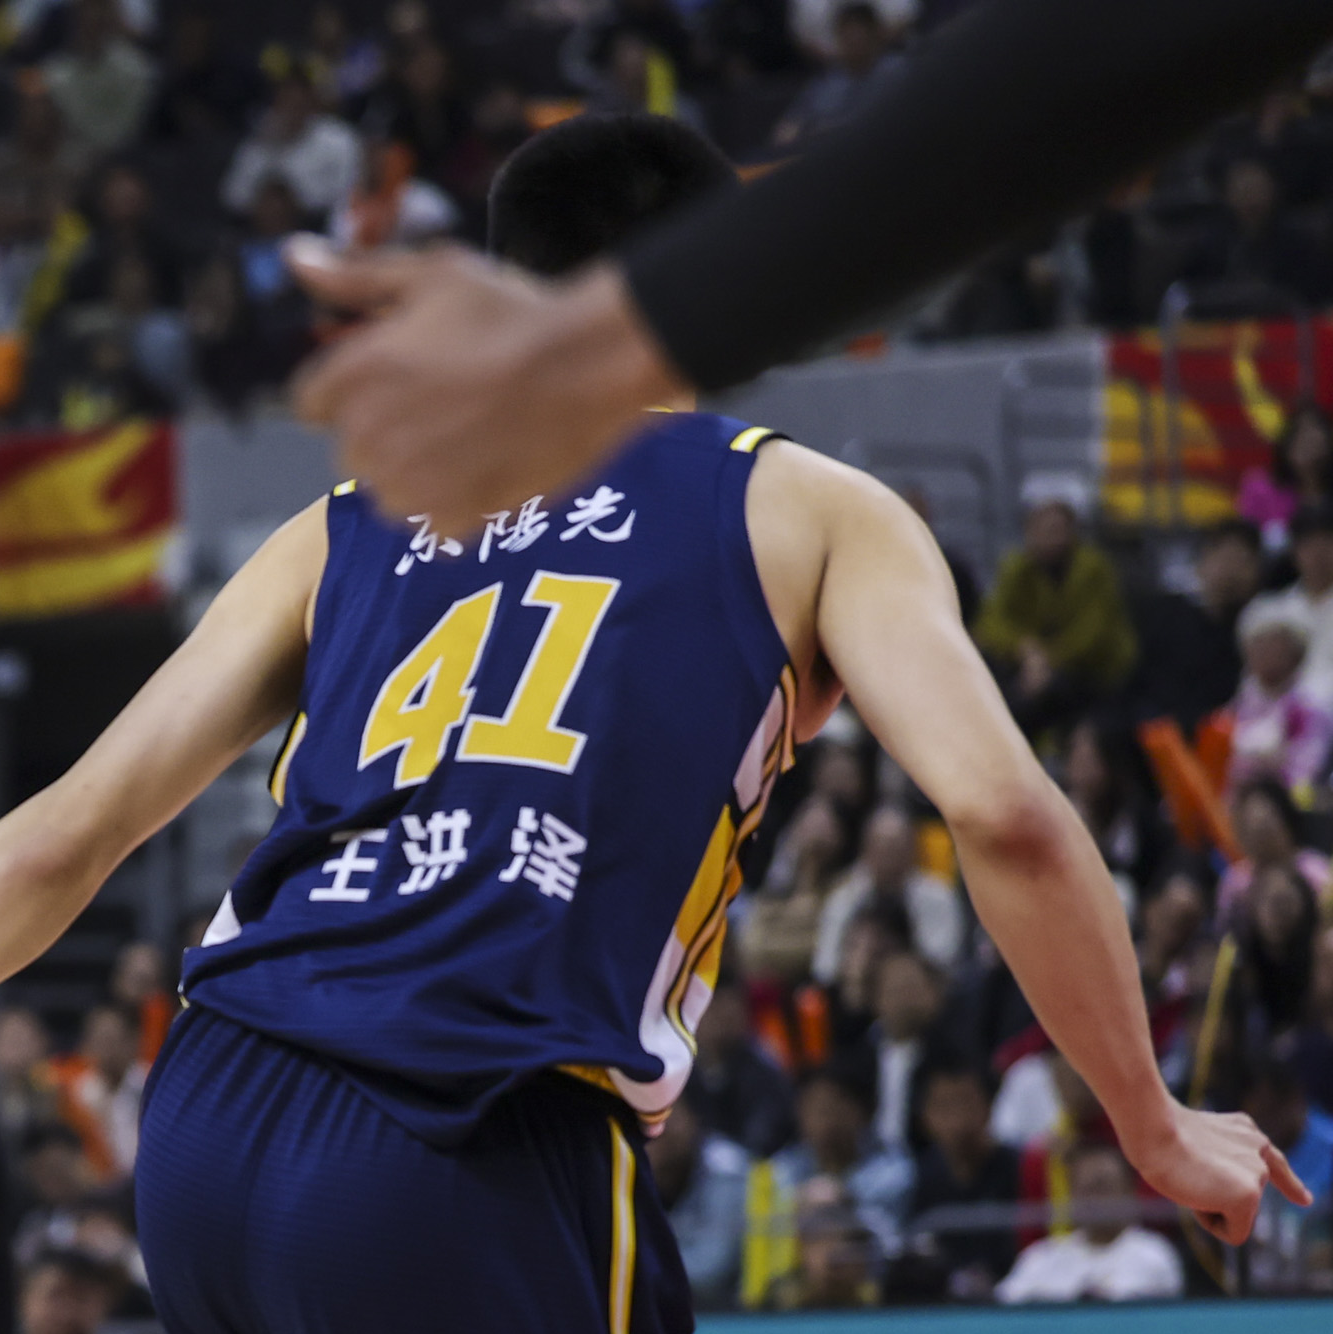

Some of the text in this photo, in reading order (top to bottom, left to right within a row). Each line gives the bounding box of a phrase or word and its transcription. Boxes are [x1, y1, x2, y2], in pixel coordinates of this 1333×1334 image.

[357, 569, 621, 789] 41
[309, 807, 588, 902] 王洪泽
